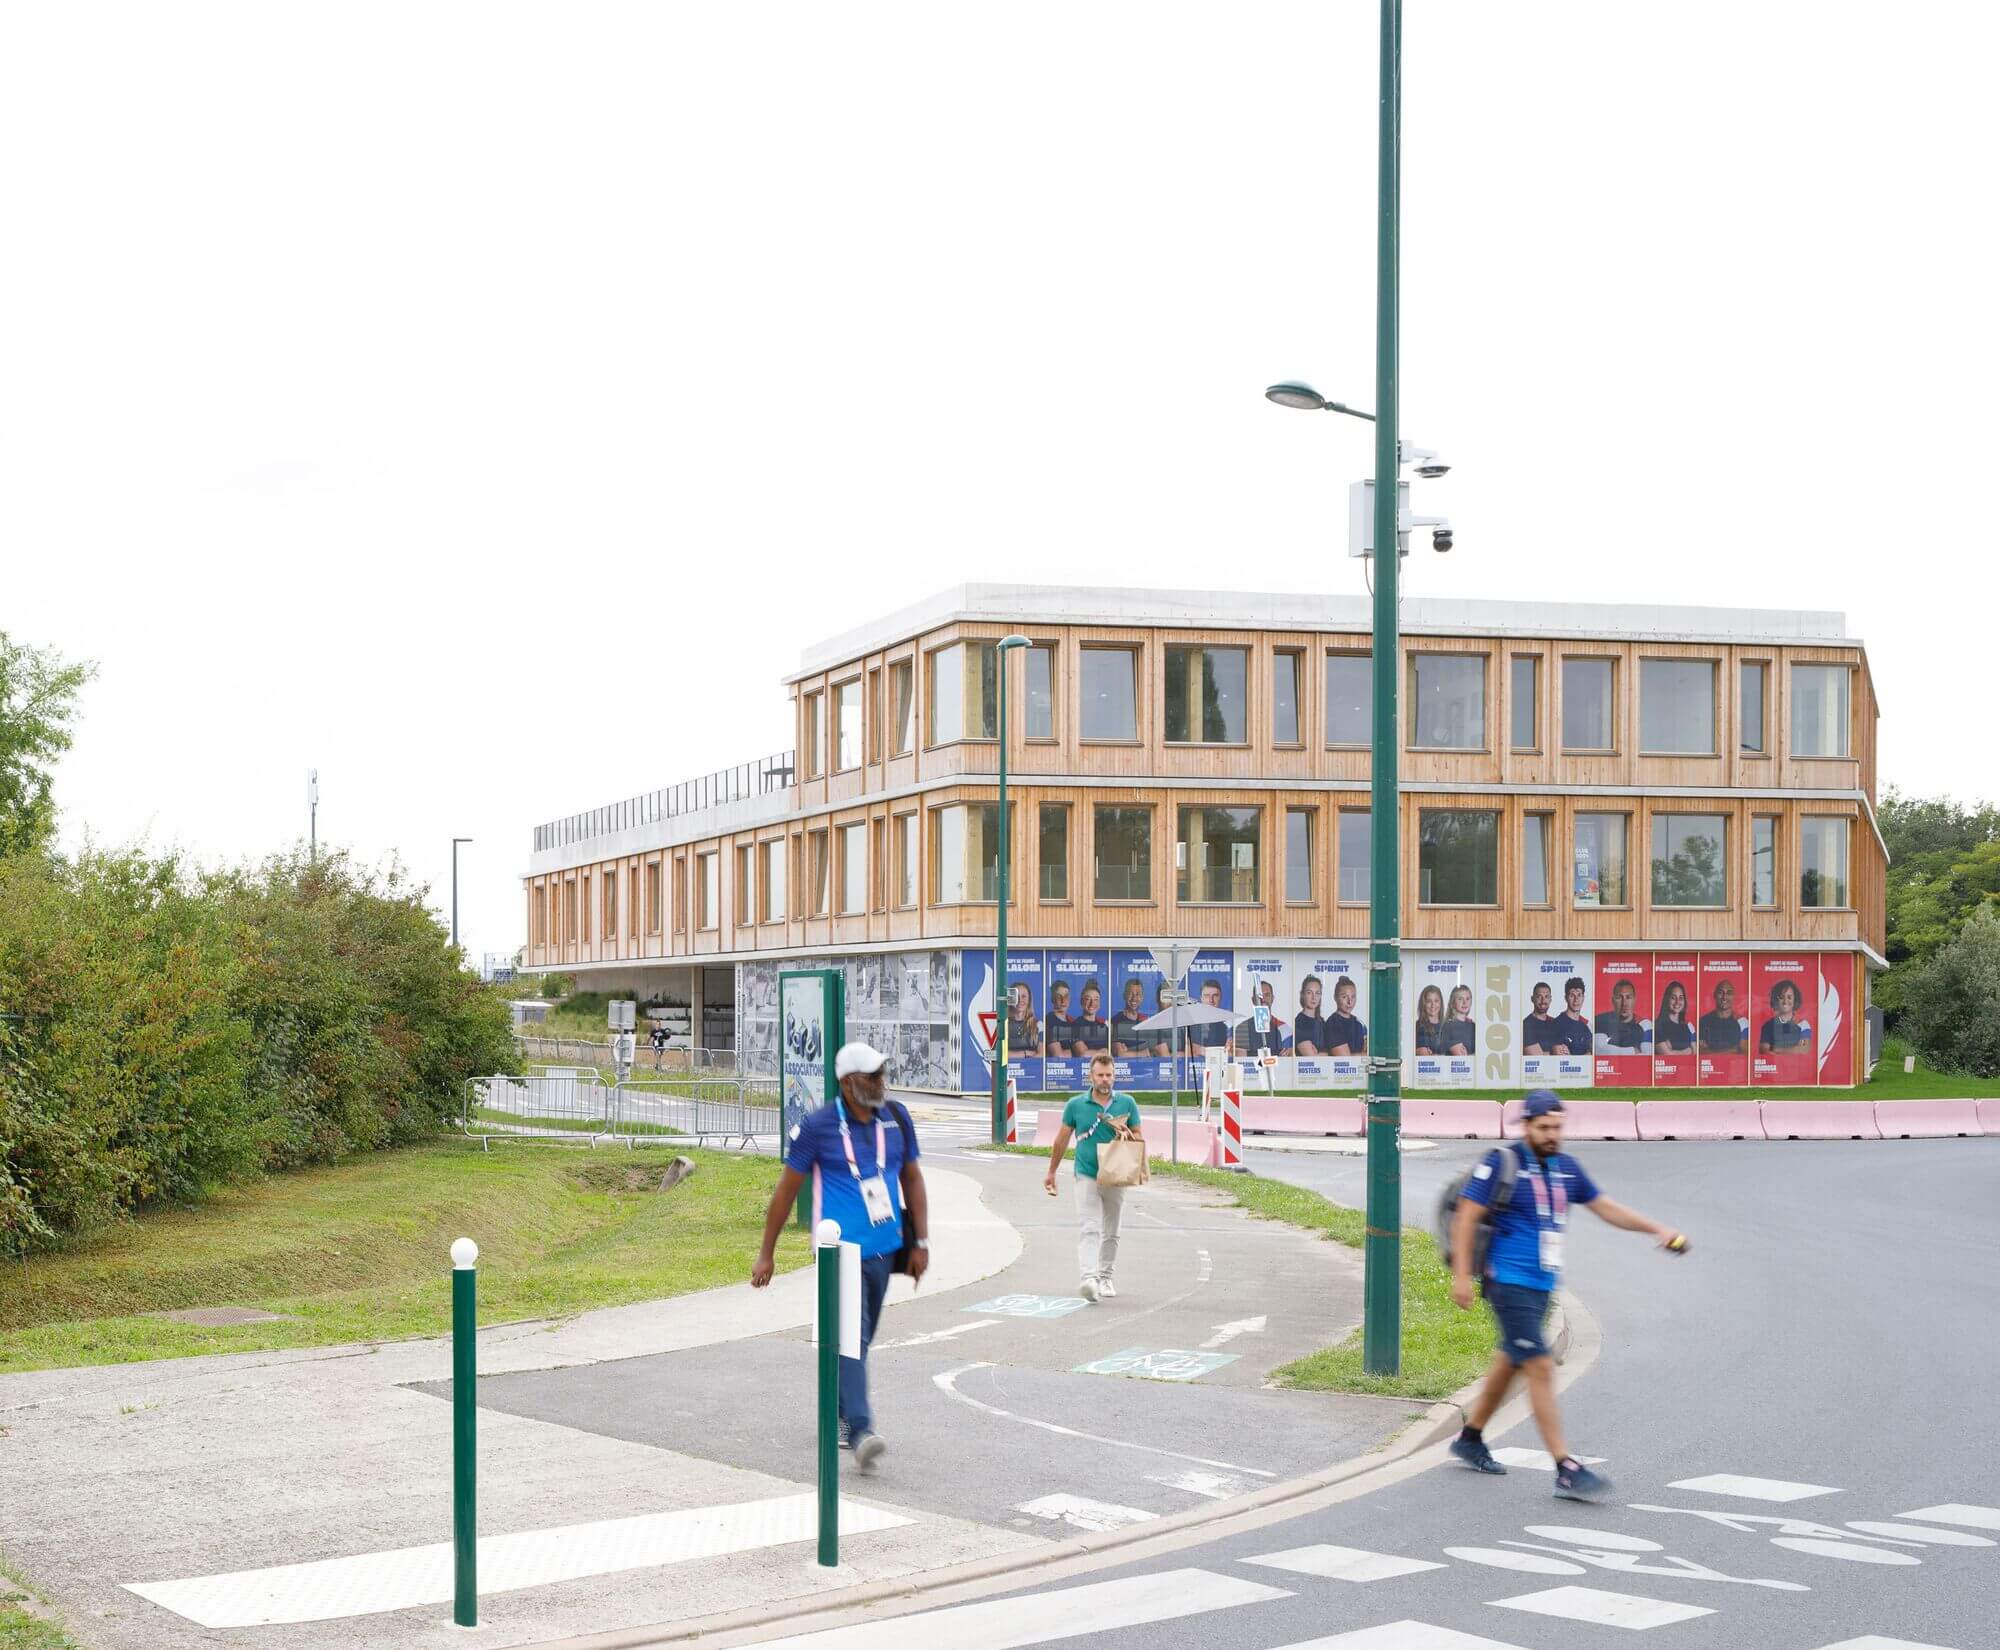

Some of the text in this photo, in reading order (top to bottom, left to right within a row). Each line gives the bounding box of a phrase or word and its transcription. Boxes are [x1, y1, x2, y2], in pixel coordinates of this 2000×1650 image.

[1007, 964, 1040, 972] LALOM
[1056, 964, 1097, 972] SLALOM
[1128, 964, 1161, 972] SLALO
[1486, 965, 1511, 1080] 2024
